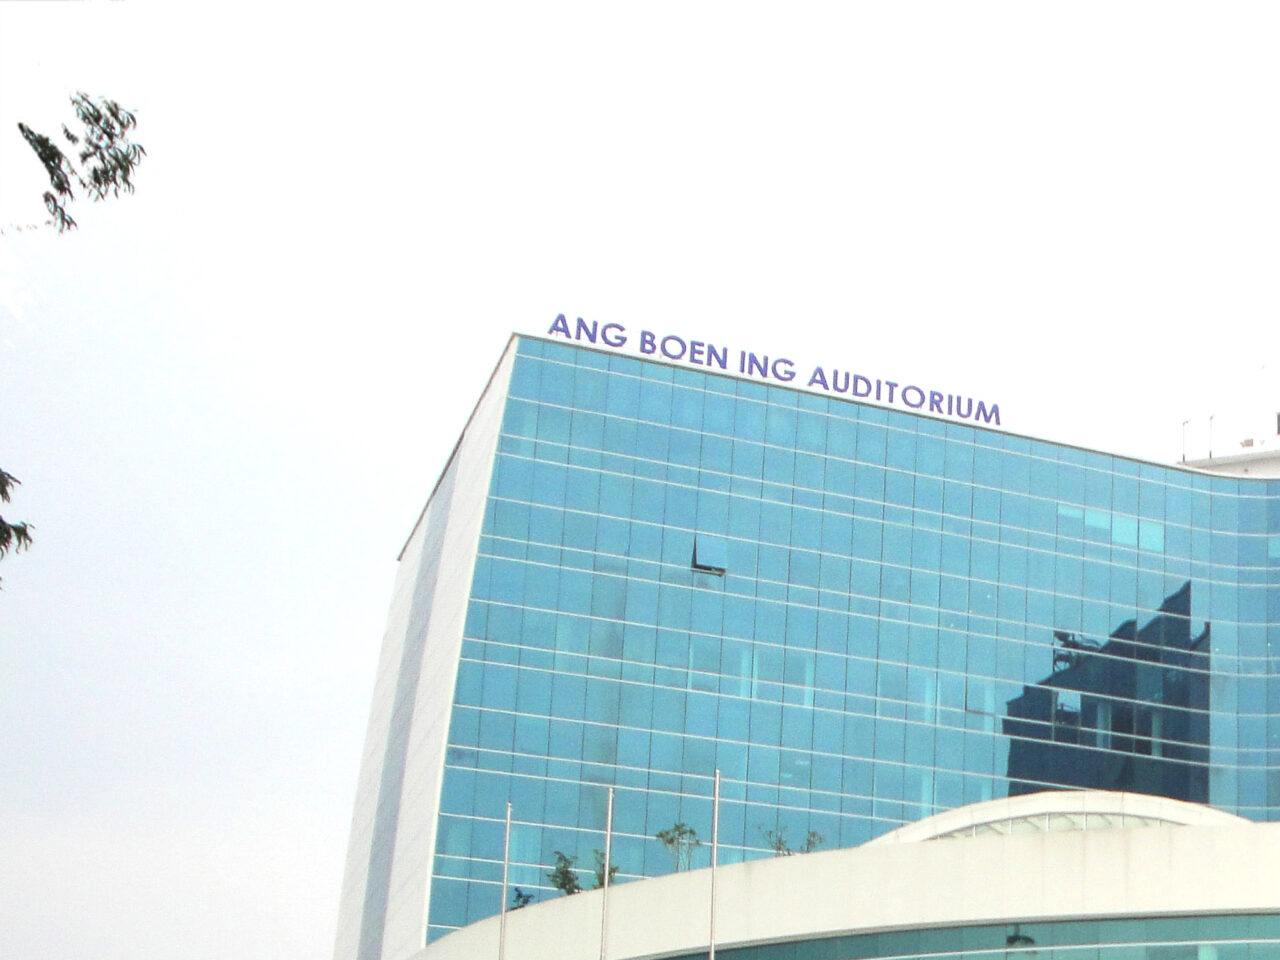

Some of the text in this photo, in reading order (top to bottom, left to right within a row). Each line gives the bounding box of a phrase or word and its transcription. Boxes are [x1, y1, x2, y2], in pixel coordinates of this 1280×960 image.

[547, 313, 1001, 426] ANG BOEN ING AUDITORIUM
